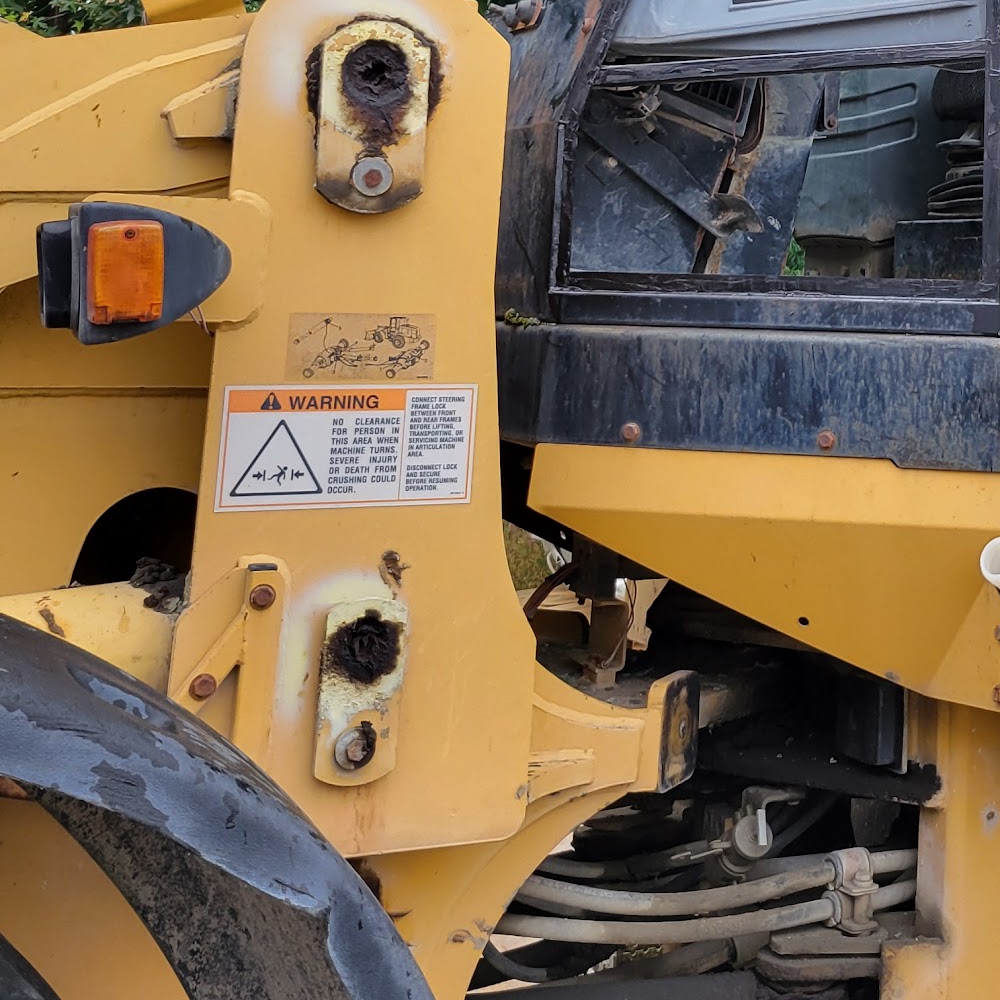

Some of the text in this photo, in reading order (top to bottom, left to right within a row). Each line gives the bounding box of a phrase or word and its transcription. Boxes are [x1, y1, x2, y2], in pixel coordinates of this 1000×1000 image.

[289, 394, 380, 410] WARNING
[332, 417, 400, 426] NO CLEARANCE
[332, 426, 400, 435] FOR PERSON IN
[331, 436, 399, 445] THIS AREA WHEN
[330, 446, 398, 455] MACHINE TURNS.
[329, 455, 398, 465] SEVERE INJURY
[328, 465, 397, 474] OR DEATH FROM
[327, 474, 396, 484] CRUSHING COULD
[327, 485, 356, 494] OCCUR.
